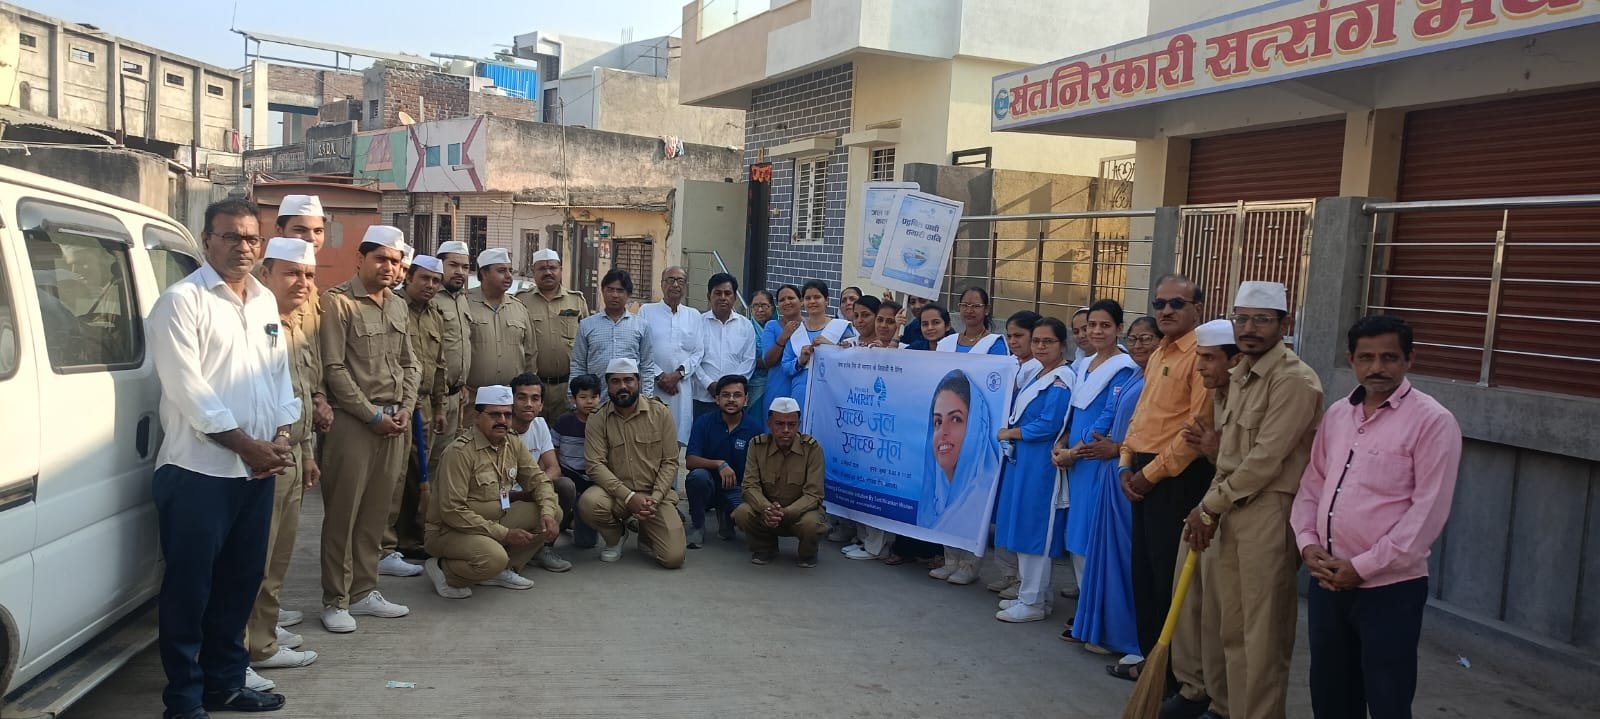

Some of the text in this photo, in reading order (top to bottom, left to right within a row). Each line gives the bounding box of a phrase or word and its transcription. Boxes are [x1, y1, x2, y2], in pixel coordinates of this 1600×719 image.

[1205, 0, 1398, 81] सत्संग
[847, 388, 875, 406] AMRIT
[836, 406, 896, 438] स्वच्छ जल
[842, 431, 875, 454] स्वच्छ
[877, 437, 902, 465] मन
